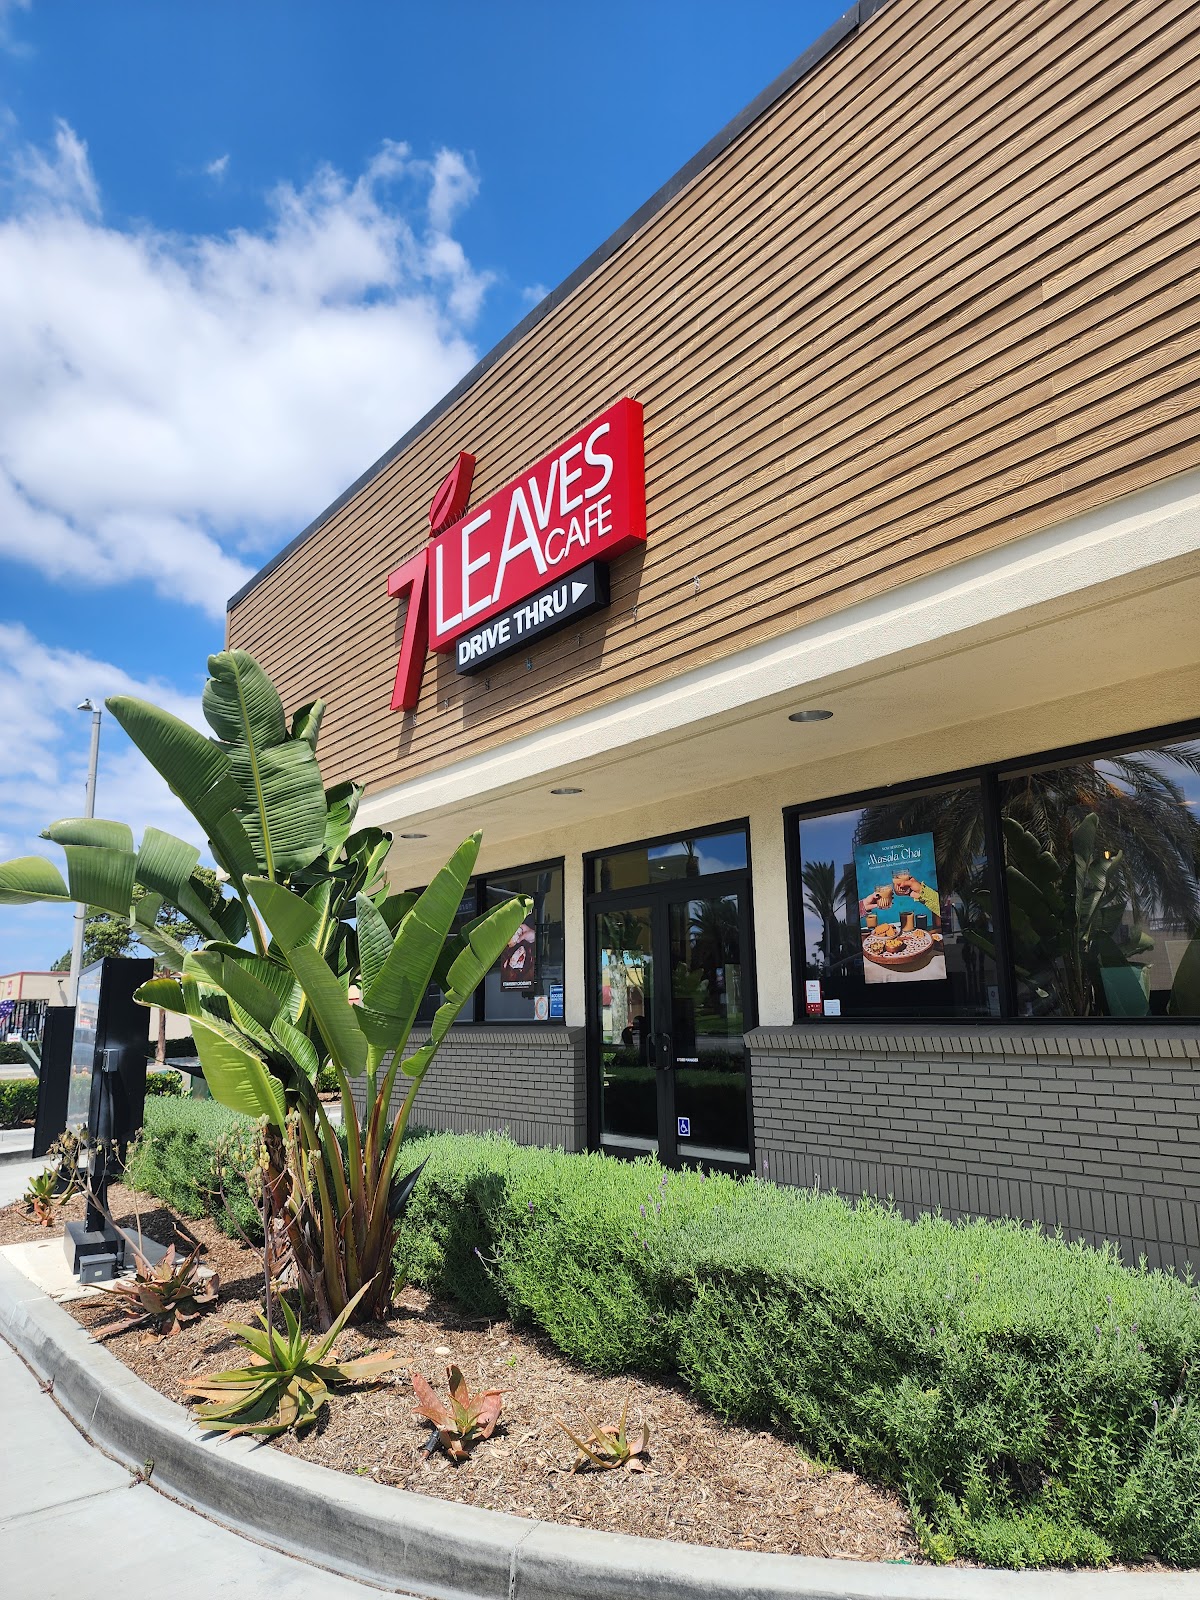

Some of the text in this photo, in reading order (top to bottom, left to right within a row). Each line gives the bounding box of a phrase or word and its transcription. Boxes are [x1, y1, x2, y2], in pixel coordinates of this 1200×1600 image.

[436, 422, 614, 637] LEAVES
[545, 494, 612, 565] CAFE
[458, 584, 568, 666] DRIVE THRU
[867, 850, 900, 866] Masala
[901, 847, 921, 860] Chai
